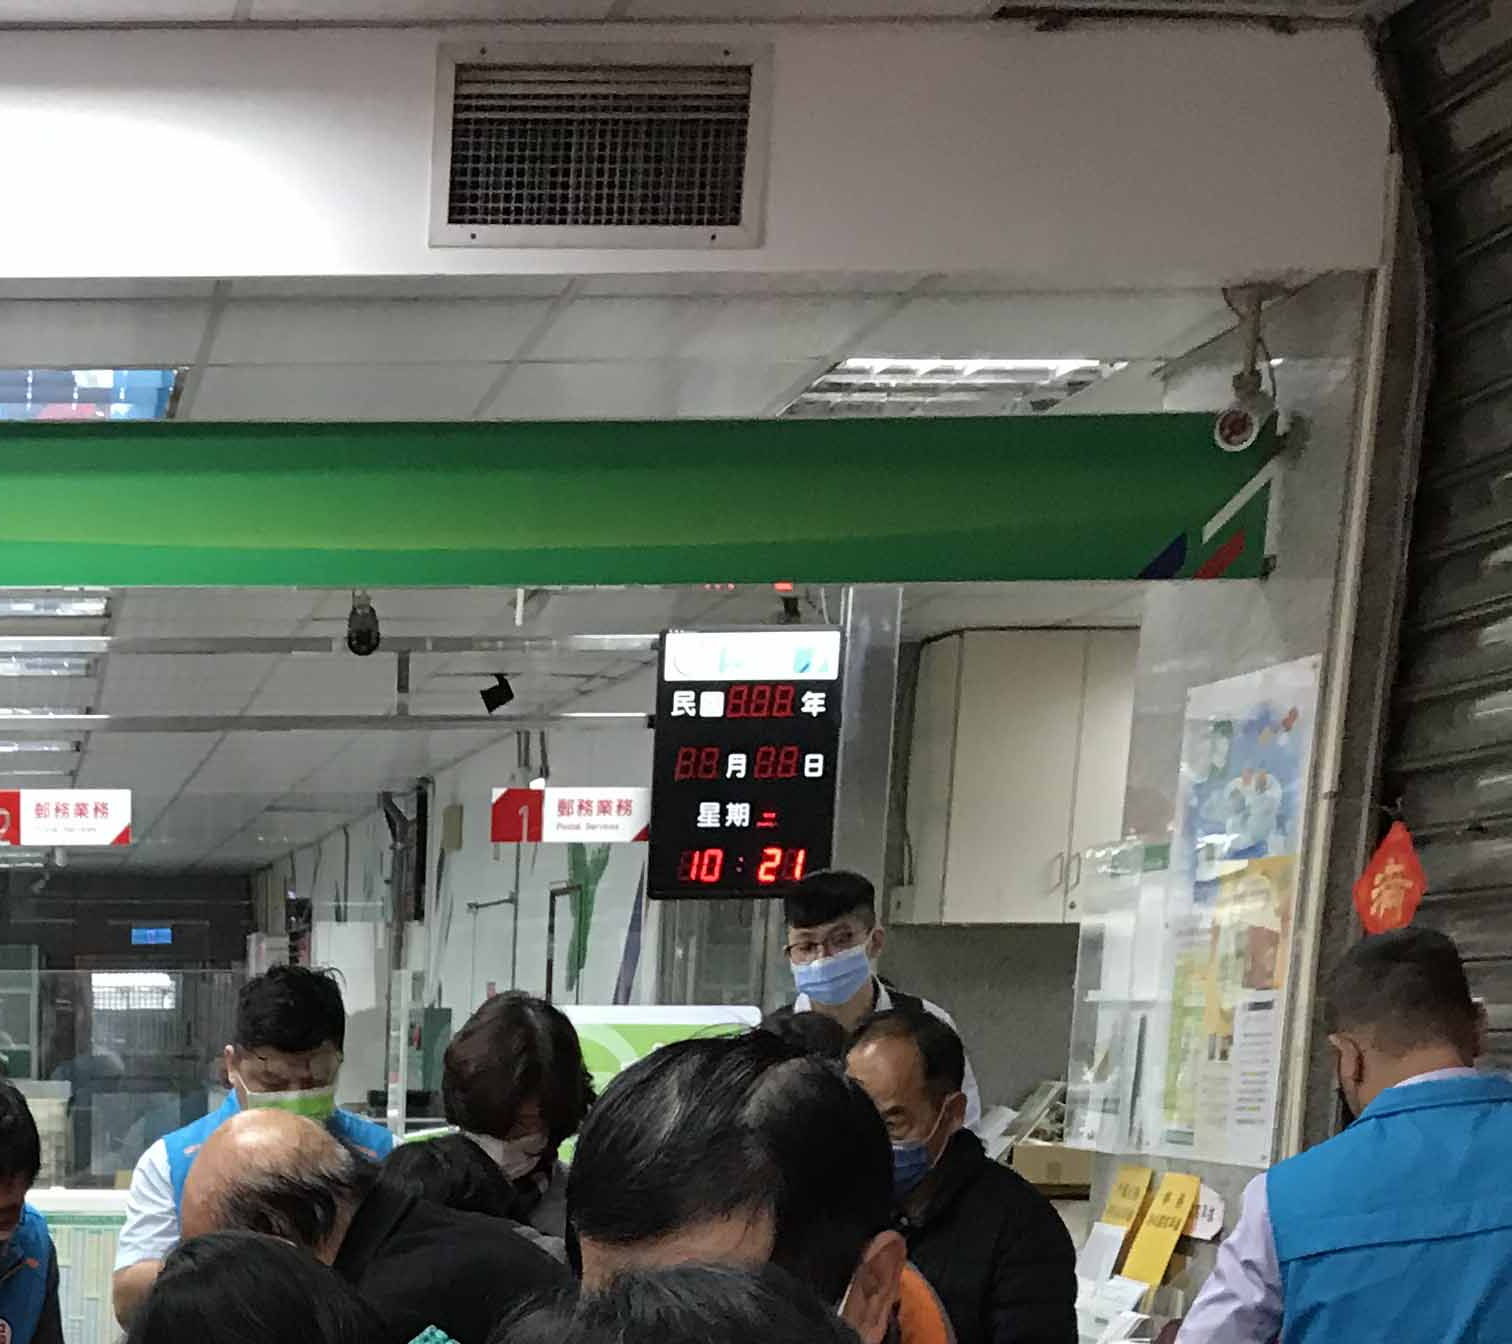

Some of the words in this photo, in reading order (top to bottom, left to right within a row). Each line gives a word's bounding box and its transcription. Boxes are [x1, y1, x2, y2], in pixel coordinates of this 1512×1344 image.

[557, 798, 633, 817] 郵務業務
[518, 805, 528, 842] 1
